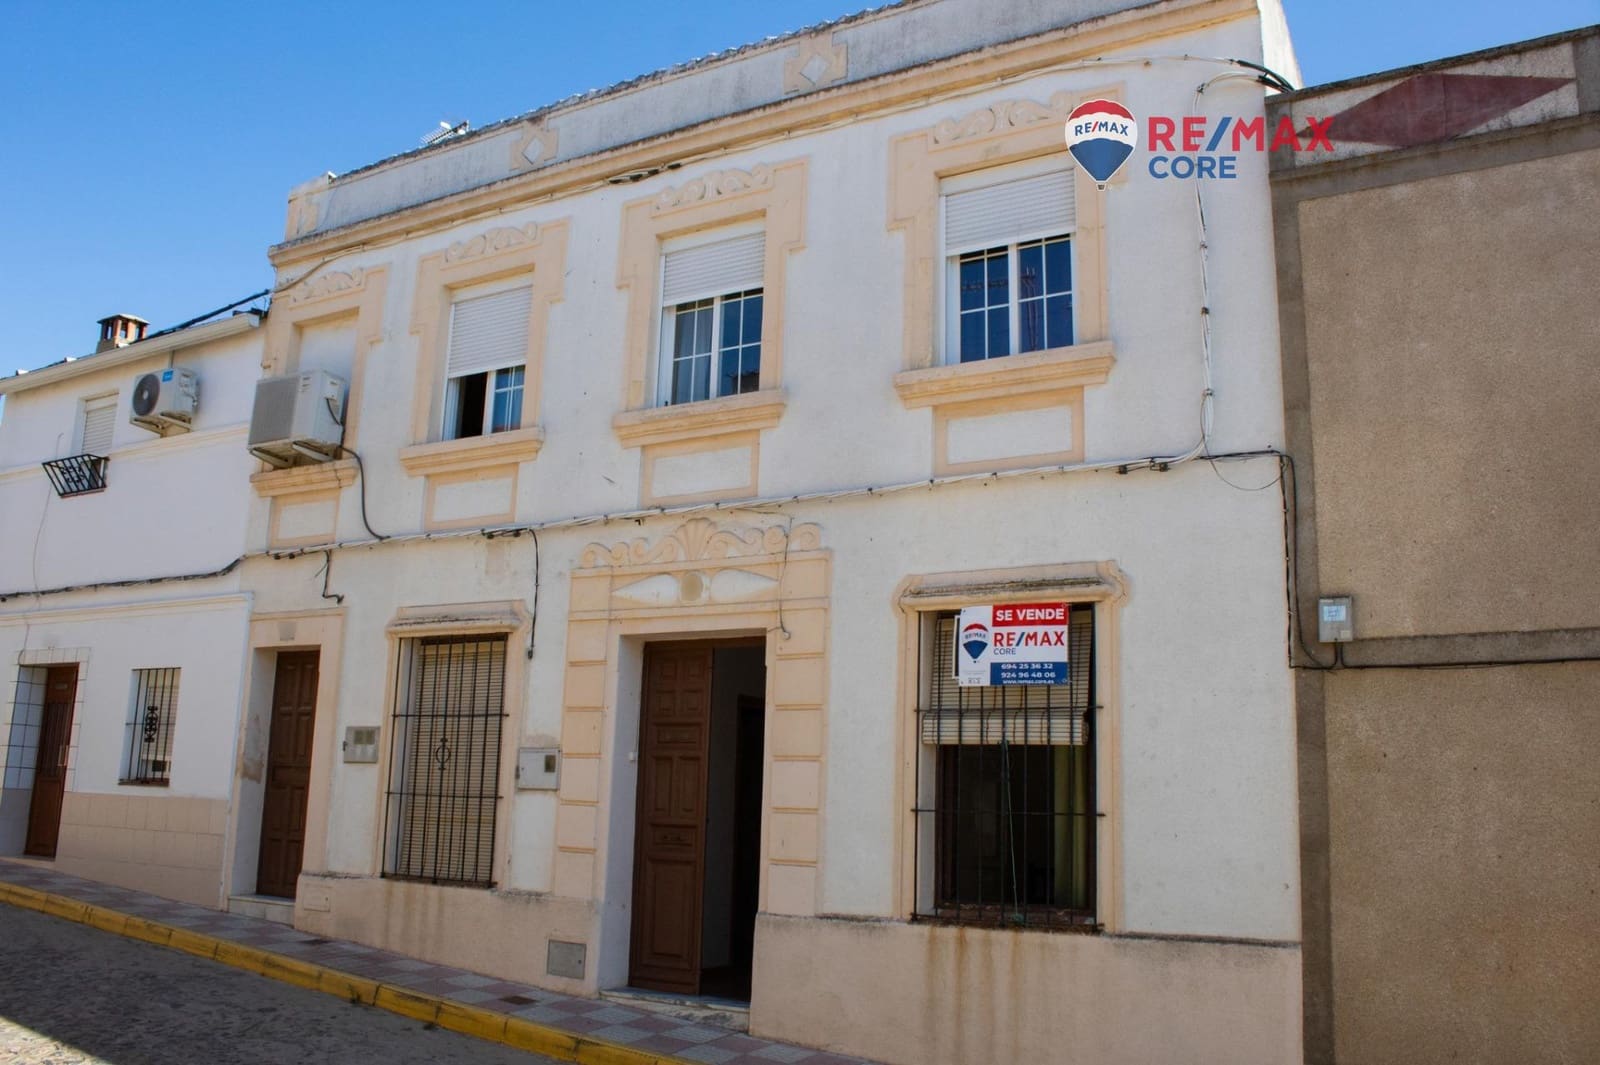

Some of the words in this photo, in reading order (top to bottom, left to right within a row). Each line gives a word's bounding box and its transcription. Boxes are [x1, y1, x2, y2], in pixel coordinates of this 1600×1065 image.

[996, 609, 1013, 621] SE
[1016, 608, 1065, 620] VENDE
[993, 631, 1065, 647] RE/MAX
[993, 648, 1017, 656] CORE
